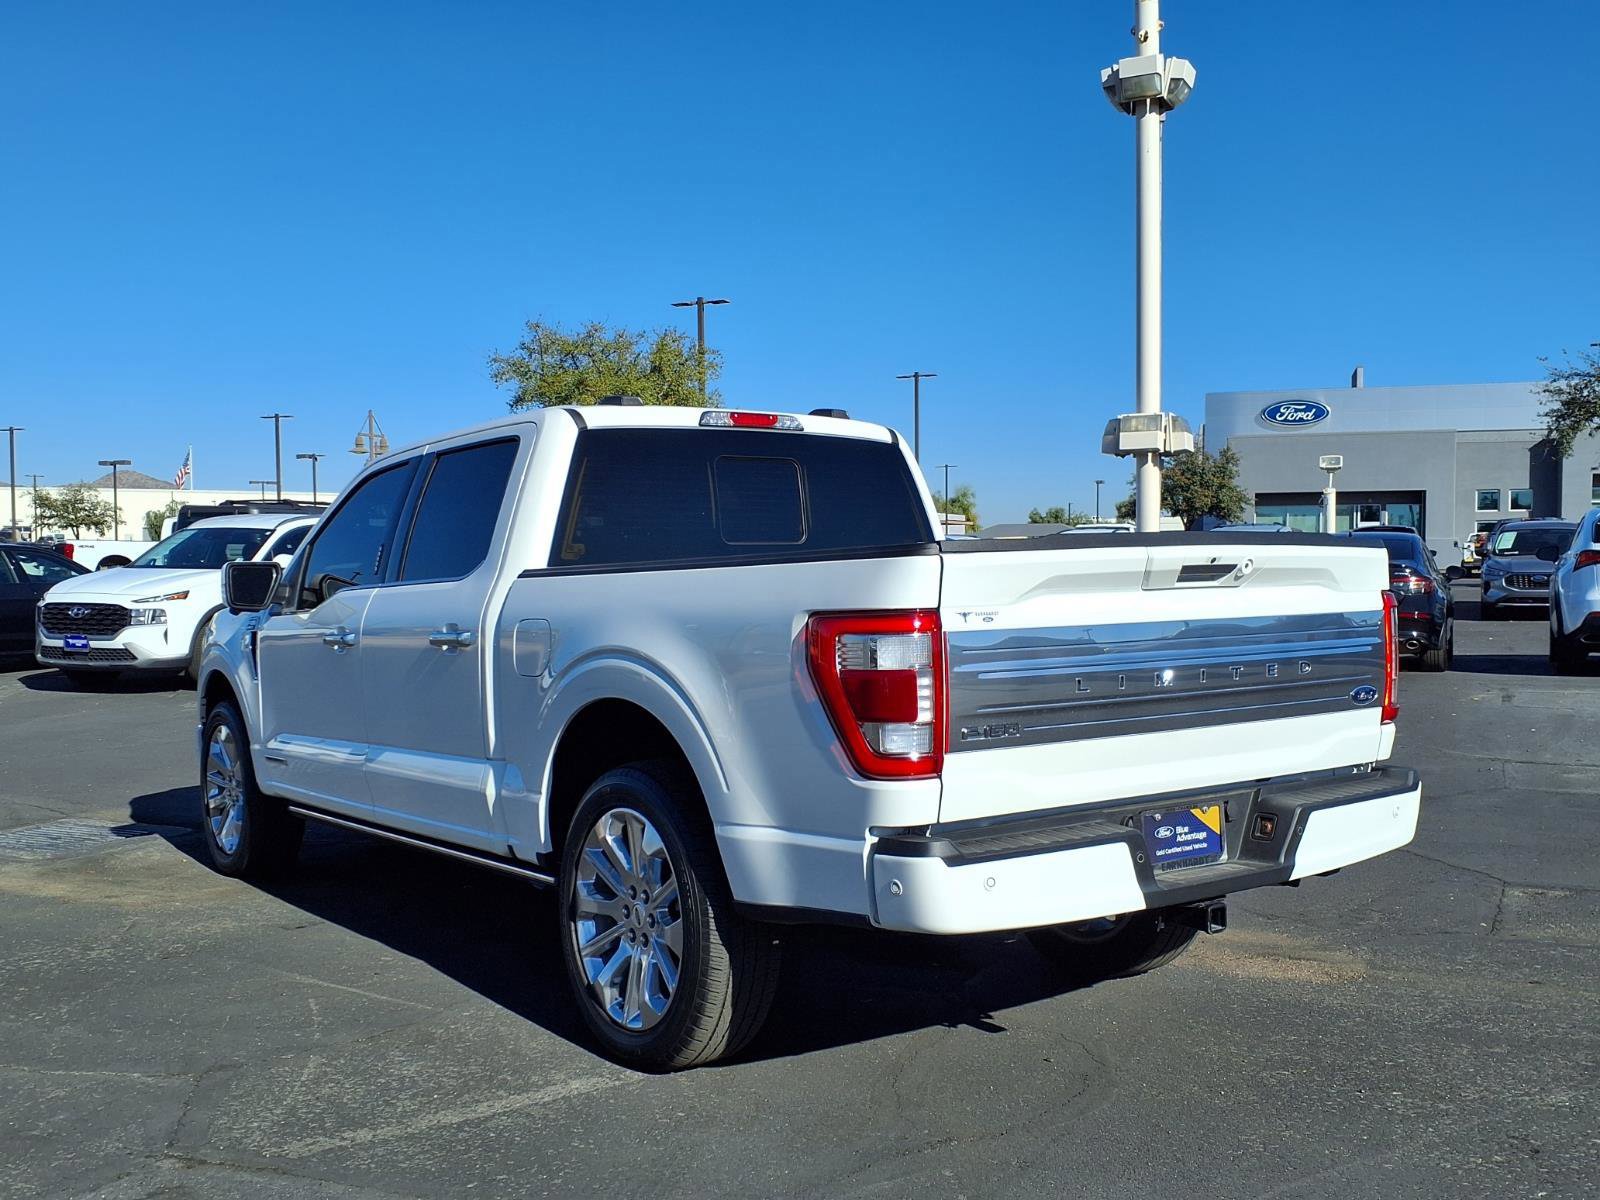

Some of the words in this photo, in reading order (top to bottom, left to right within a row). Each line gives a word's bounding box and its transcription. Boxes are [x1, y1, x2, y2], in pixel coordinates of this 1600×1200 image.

[1275, 404, 1317, 421] Ford
[1075, 660, 1312, 694] LIMITED
[1176, 831, 1207, 842] Advantage
